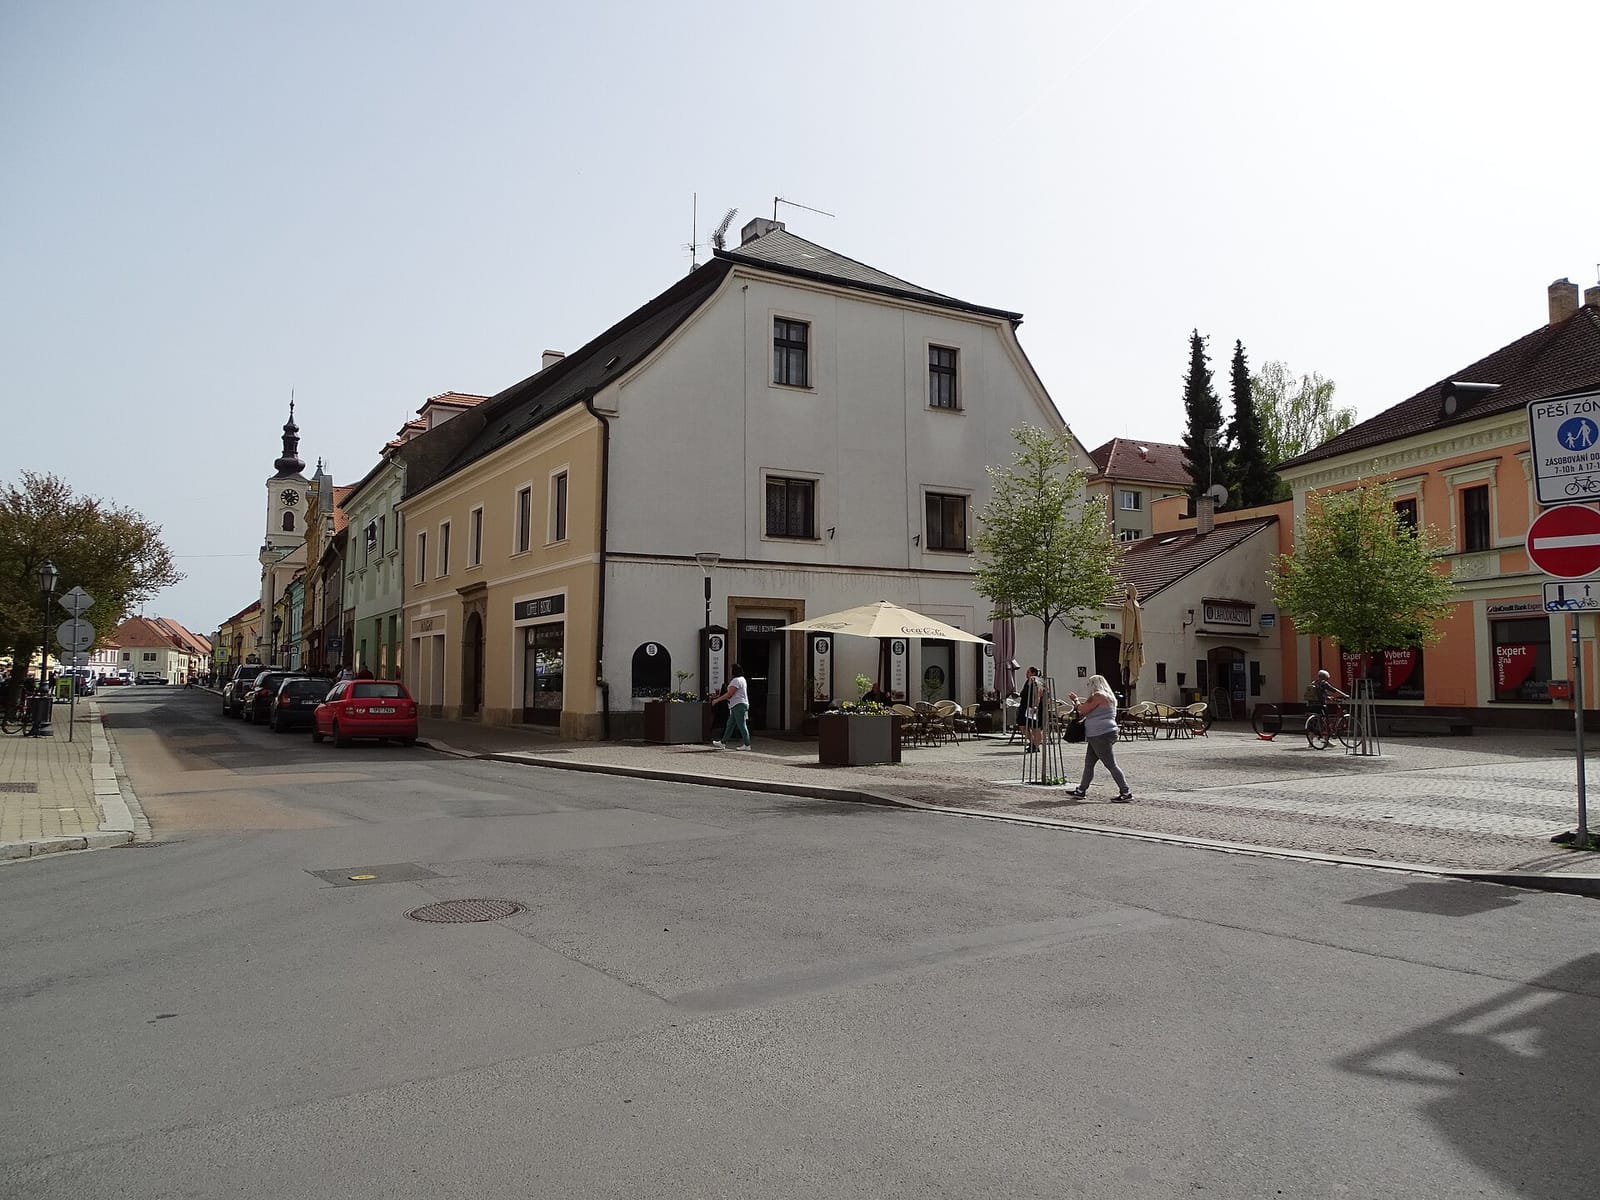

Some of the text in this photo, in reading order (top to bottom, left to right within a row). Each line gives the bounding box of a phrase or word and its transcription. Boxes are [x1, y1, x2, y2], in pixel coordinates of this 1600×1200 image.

[1537, 403, 1569, 419] PĚŠÍ
[1545, 452, 1588, 466] ZÁSOBOVÁNÍ
[1555, 466, 1575, 474] 7-10h
[1384, 650, 1411, 660] Vyberte
[1496, 645, 1527, 658] Expert
